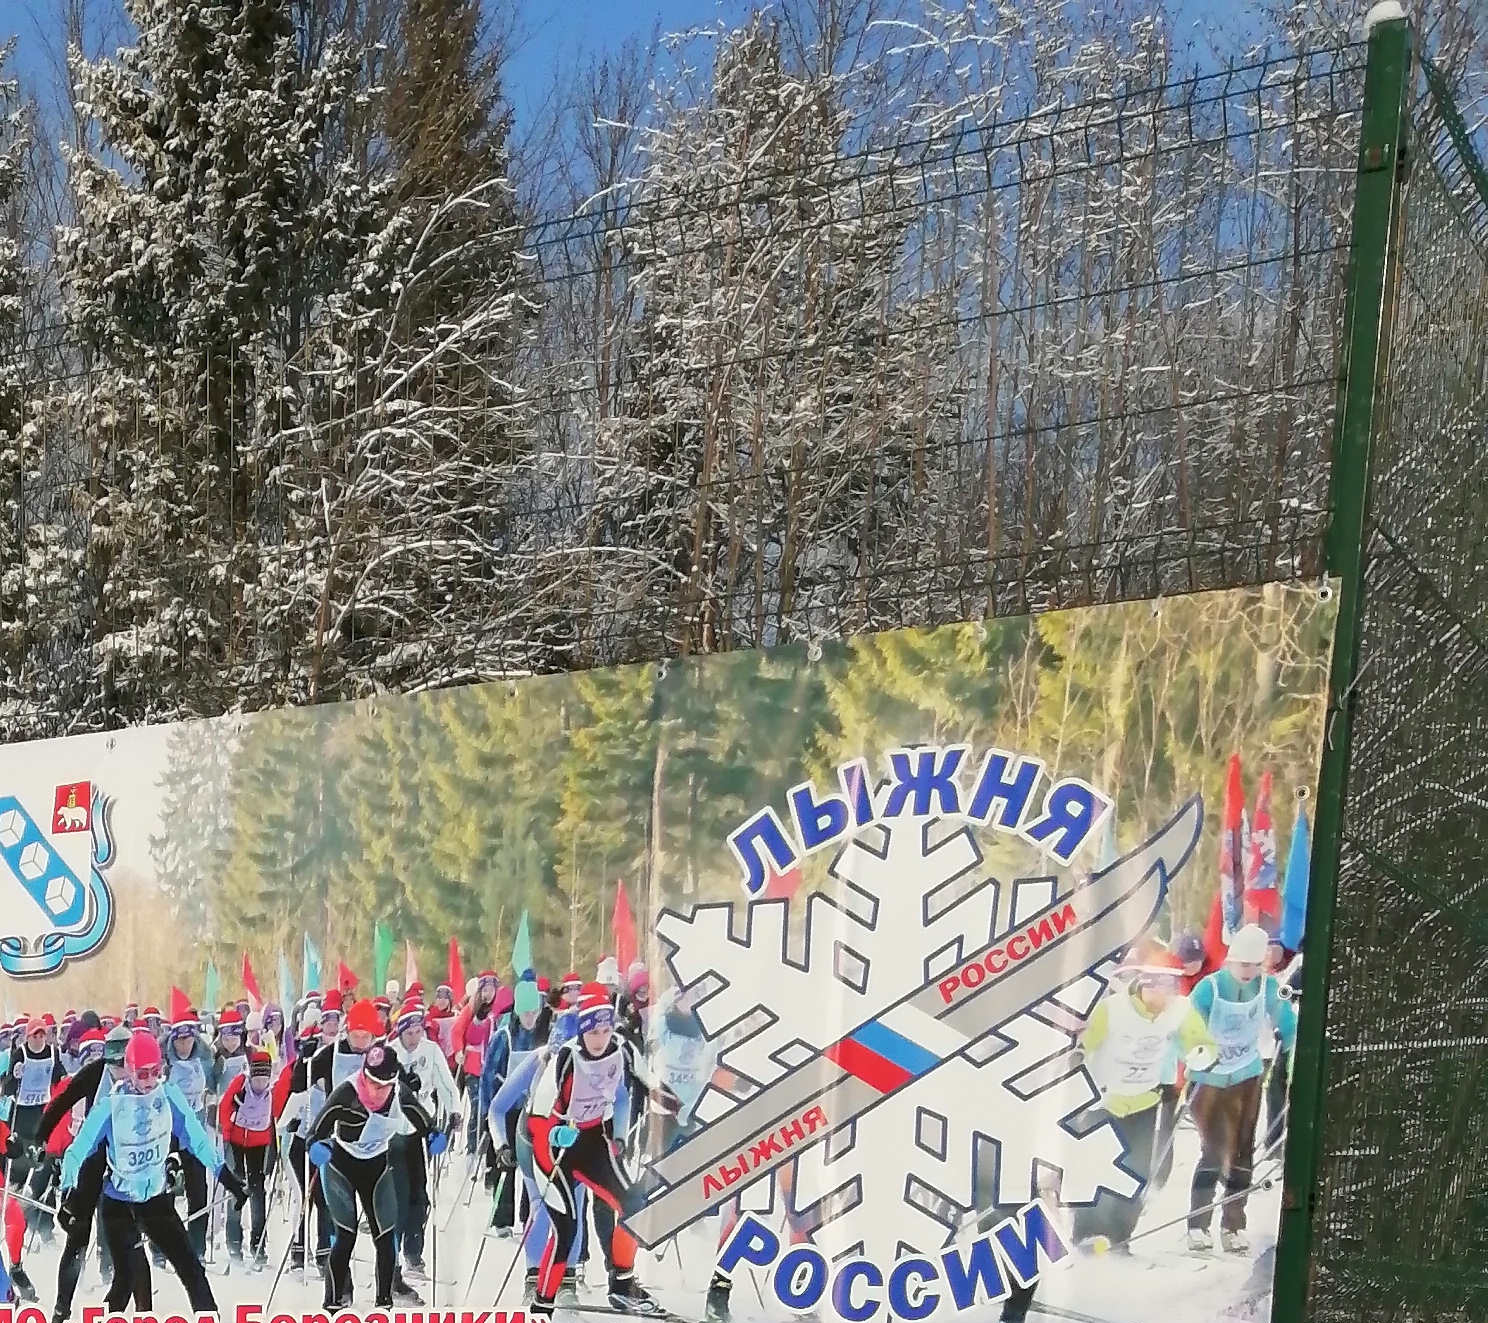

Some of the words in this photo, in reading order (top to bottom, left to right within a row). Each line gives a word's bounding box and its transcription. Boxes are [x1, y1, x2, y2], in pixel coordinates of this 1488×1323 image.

[731, 747, 1110, 892] ЛЫЖНЯ
[937, 903, 1078, 1005] РОССИИ
[127, 1143, 161, 1167] 3201
[702, 1105, 829, 1199] ЛЫЖНЯ
[717, 1203, 1071, 1323] РОССИИ
